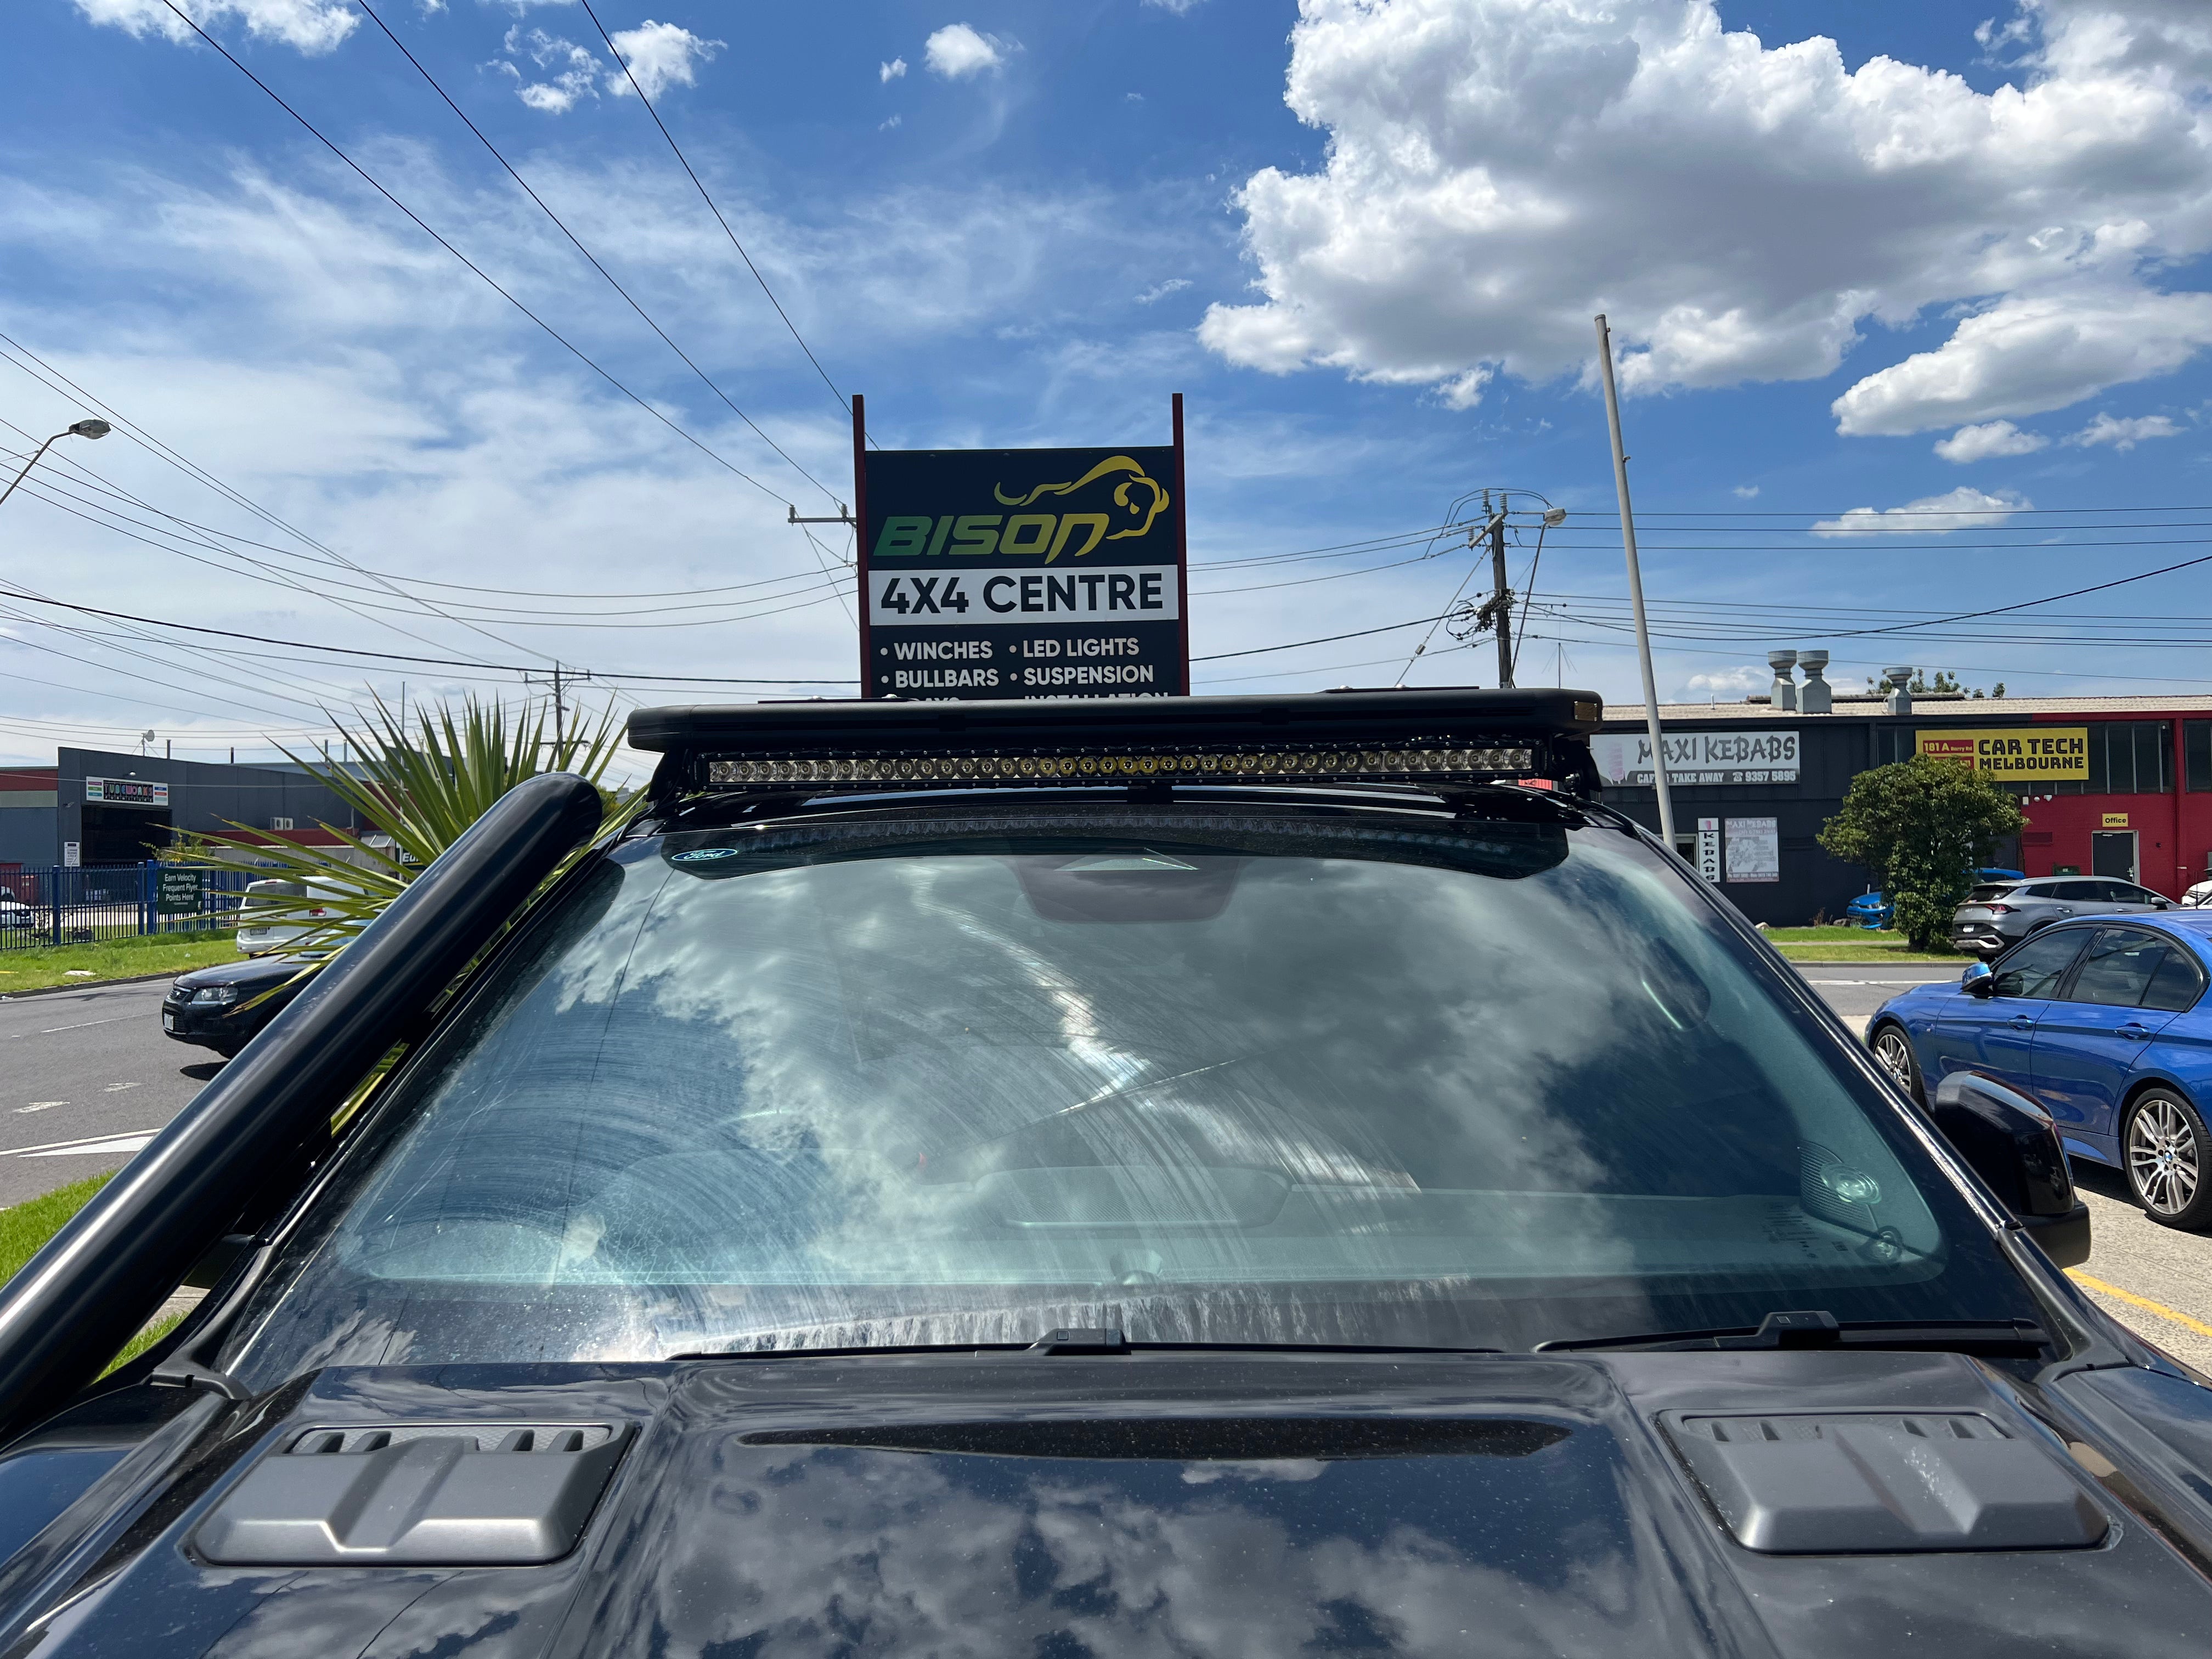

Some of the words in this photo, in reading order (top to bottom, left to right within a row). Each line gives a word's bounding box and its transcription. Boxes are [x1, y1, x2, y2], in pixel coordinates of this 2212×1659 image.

[881, 577, 969, 614] 4X4
[983, 573, 1163, 613] CENTRE
[894, 640, 992, 660] WINCHES
[1023, 639, 1060, 658] LED
[1066, 637, 1139, 657] LIGHTS
[895, 668, 999, 688] BULLBARS
[1023, 664, 1154, 686] SUSPENSION
[1638, 737, 1696, 764] MAXI
[1705, 735, 1795, 764] KEBABS
[1924, 742, 1939, 752] 181
[1942, 742, 1950, 751] A
[1978, 739, 2022, 755] CAR
[2027, 738, 2084, 754] TECH
[1979, 757, 2084, 770] MELBOURNE
[1637, 773, 1656, 784] CAF
[1672, 773, 1696, 783] TAKE
[1699, 772, 1724, 782] AWAY
[1745, 771, 1769, 782] 9357
[682, 850, 726, 860] Ford
[165, 873, 176, 882] Earn
[177, 873, 196, 883] Velocity
[163, 883, 185, 893] Frequent
[166, 893, 181, 901] Points
